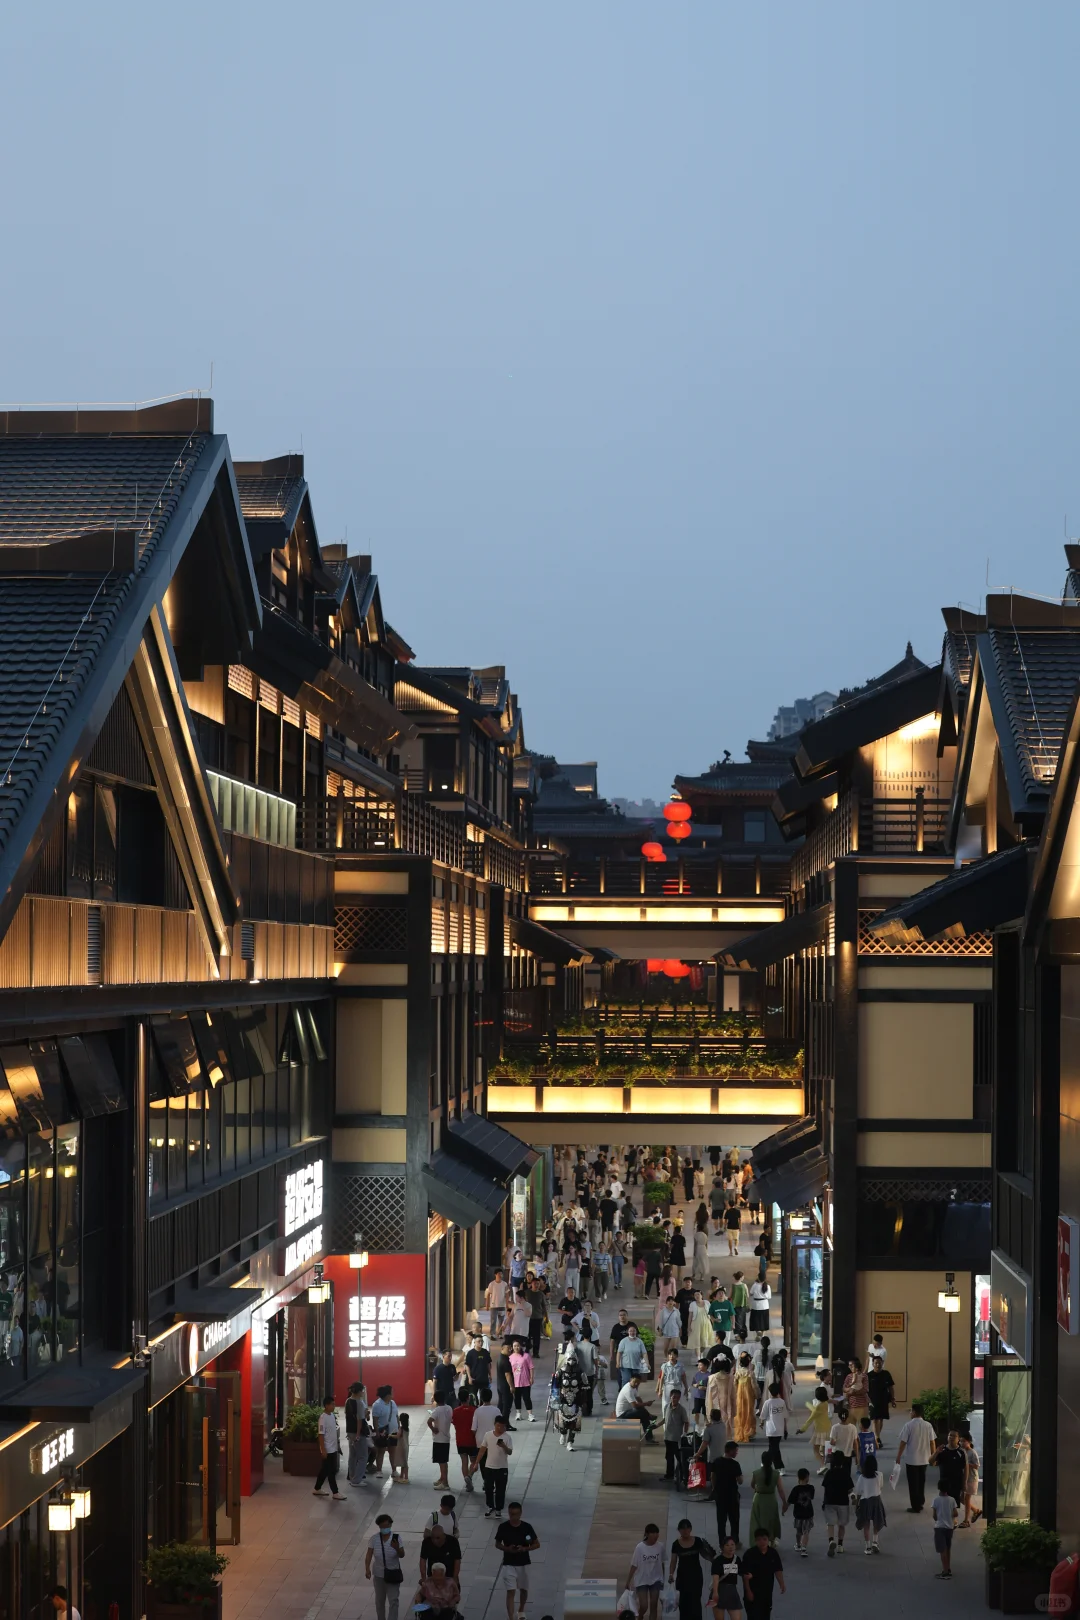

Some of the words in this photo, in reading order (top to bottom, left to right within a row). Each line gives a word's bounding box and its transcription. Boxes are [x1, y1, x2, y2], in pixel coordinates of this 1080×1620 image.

[349, 1296, 406, 1321] 超级
[204, 1320, 231, 1352] CHAGEE
[349, 1322, 406, 1347] 安踏
[864, 1443, 874, 1454] 23
